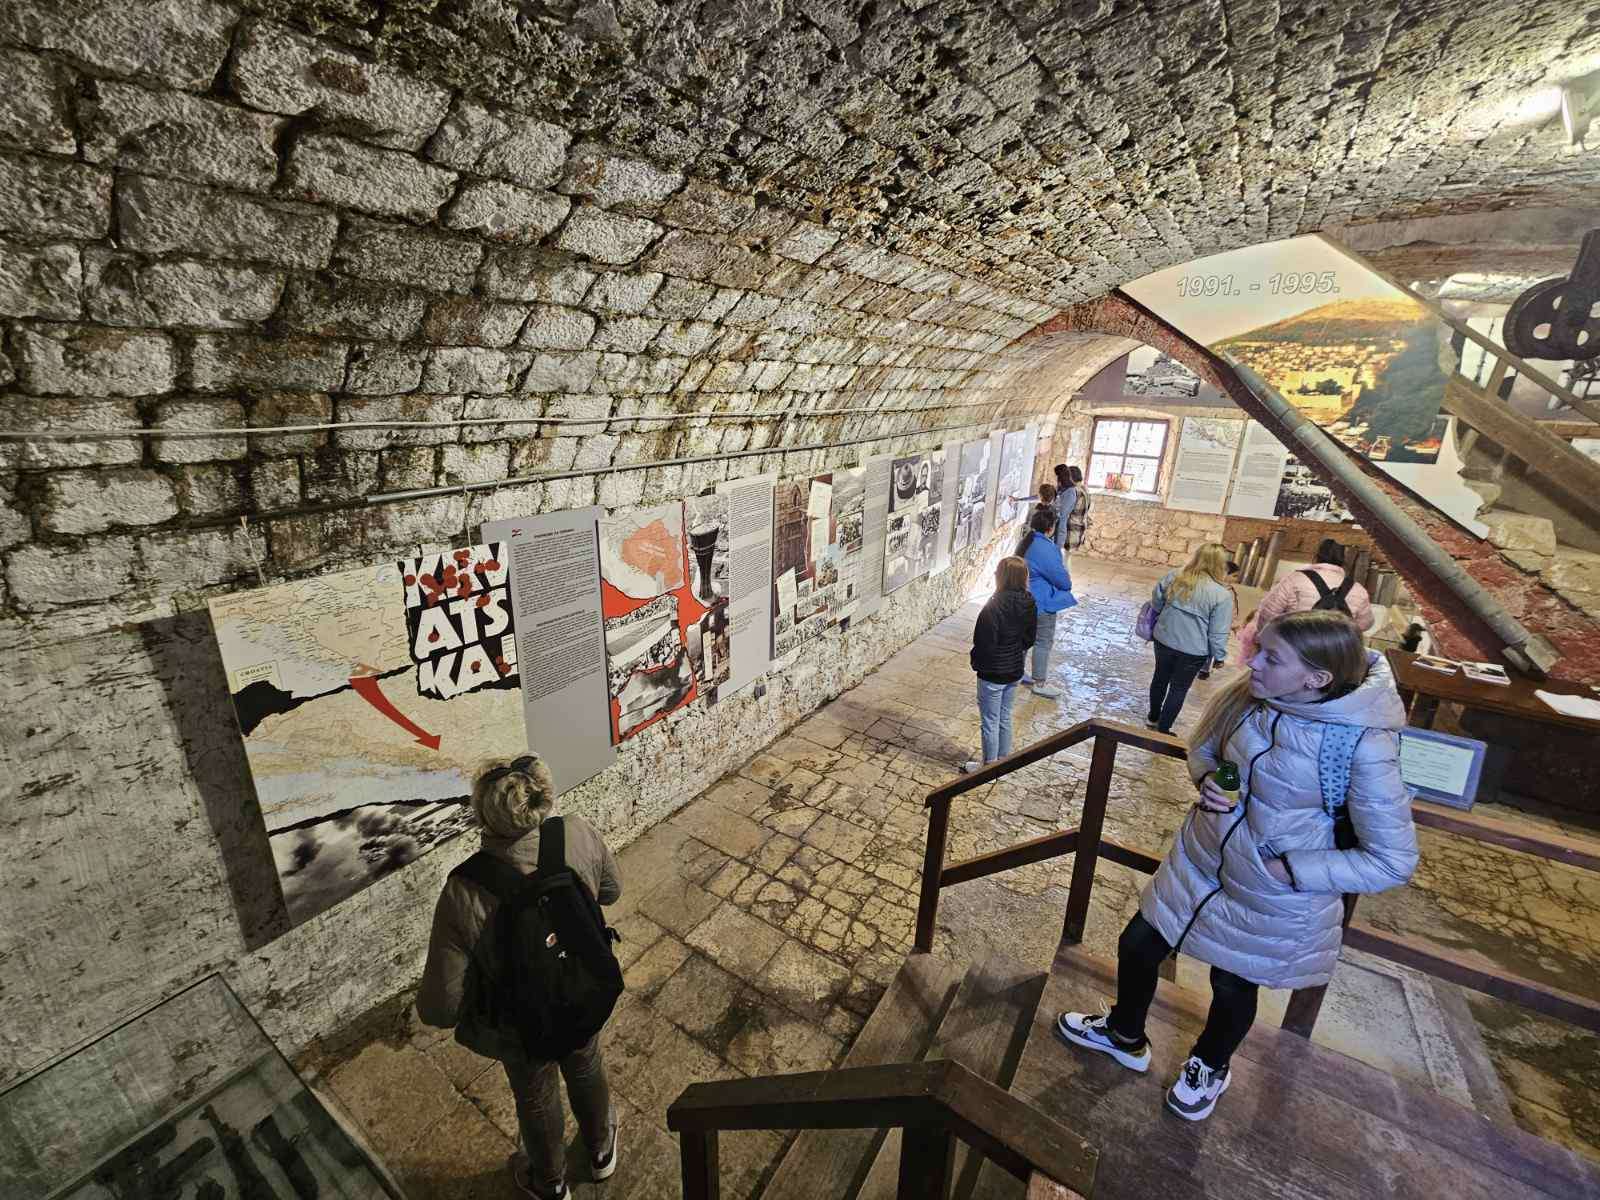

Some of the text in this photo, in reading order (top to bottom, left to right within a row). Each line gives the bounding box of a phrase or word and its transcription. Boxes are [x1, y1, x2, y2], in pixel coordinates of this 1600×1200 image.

[1177, 271, 1341, 298] 1991. - 1995.
[414, 587, 509, 660] ATS
[418, 633, 519, 700] KA!
